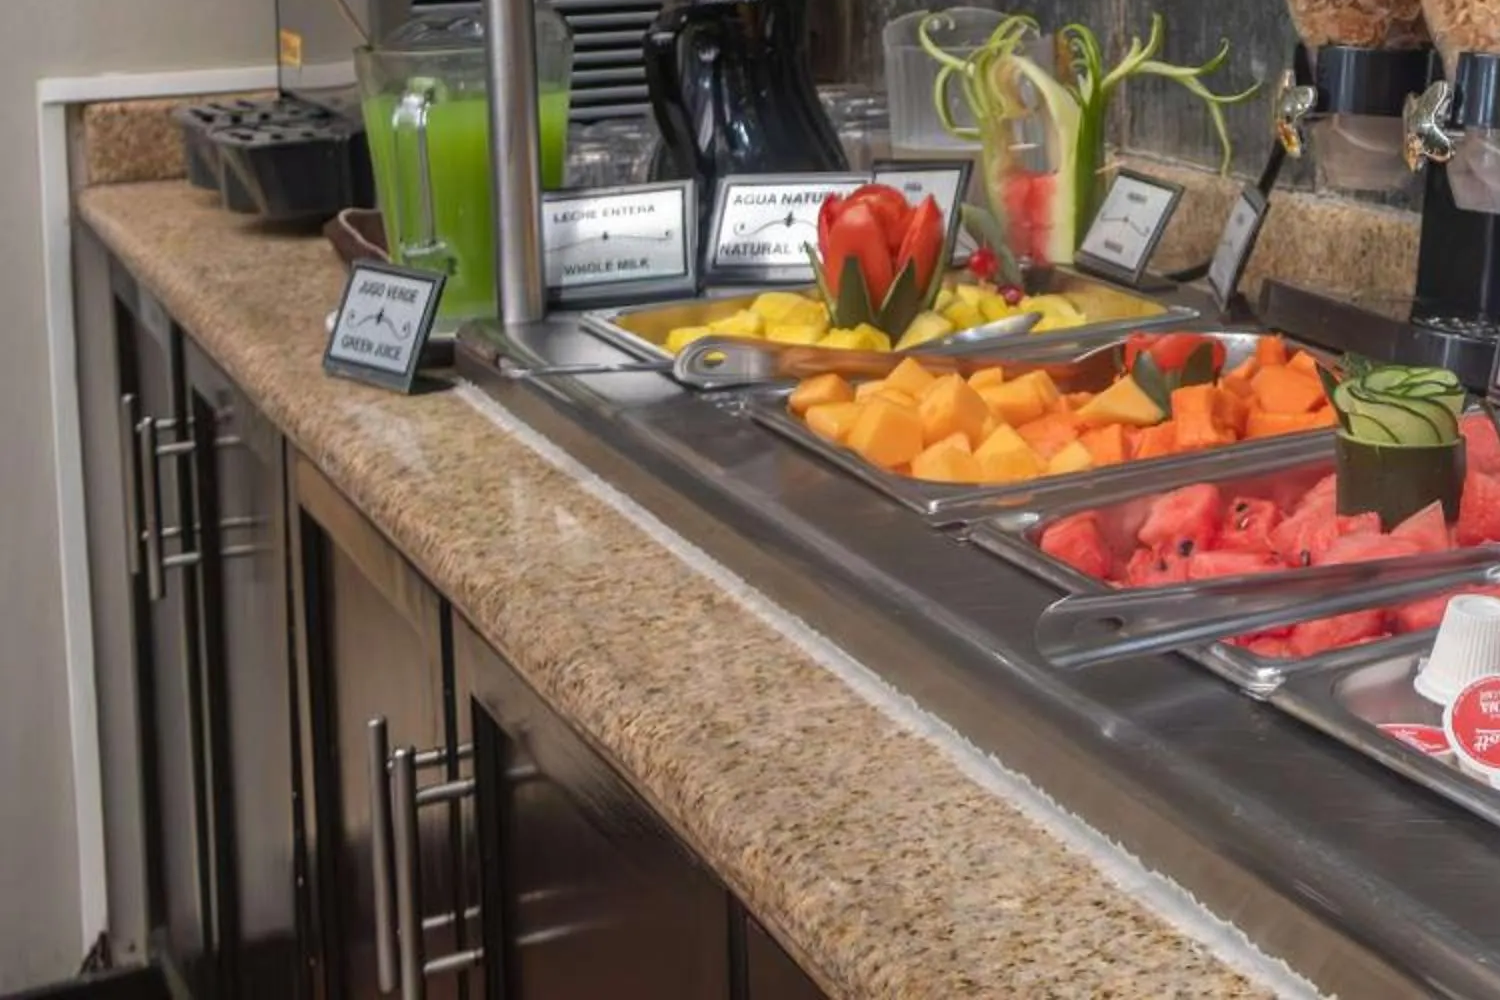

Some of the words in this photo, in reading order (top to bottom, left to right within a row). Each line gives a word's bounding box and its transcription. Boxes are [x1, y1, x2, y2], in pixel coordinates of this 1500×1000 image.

[733, 192, 777, 205] AGUA
[780, 191, 845, 205] NATU
[553, 207, 598, 223] LECHE
[602, 204, 656, 218] ENTERA
[720, 241, 792, 257] NATURAL
[563, 260, 615, 276] WHOLE
[617, 257, 650, 270] MILK
[341, 334, 375, 355] GREEN
[374, 343, 403, 361] JUICE
